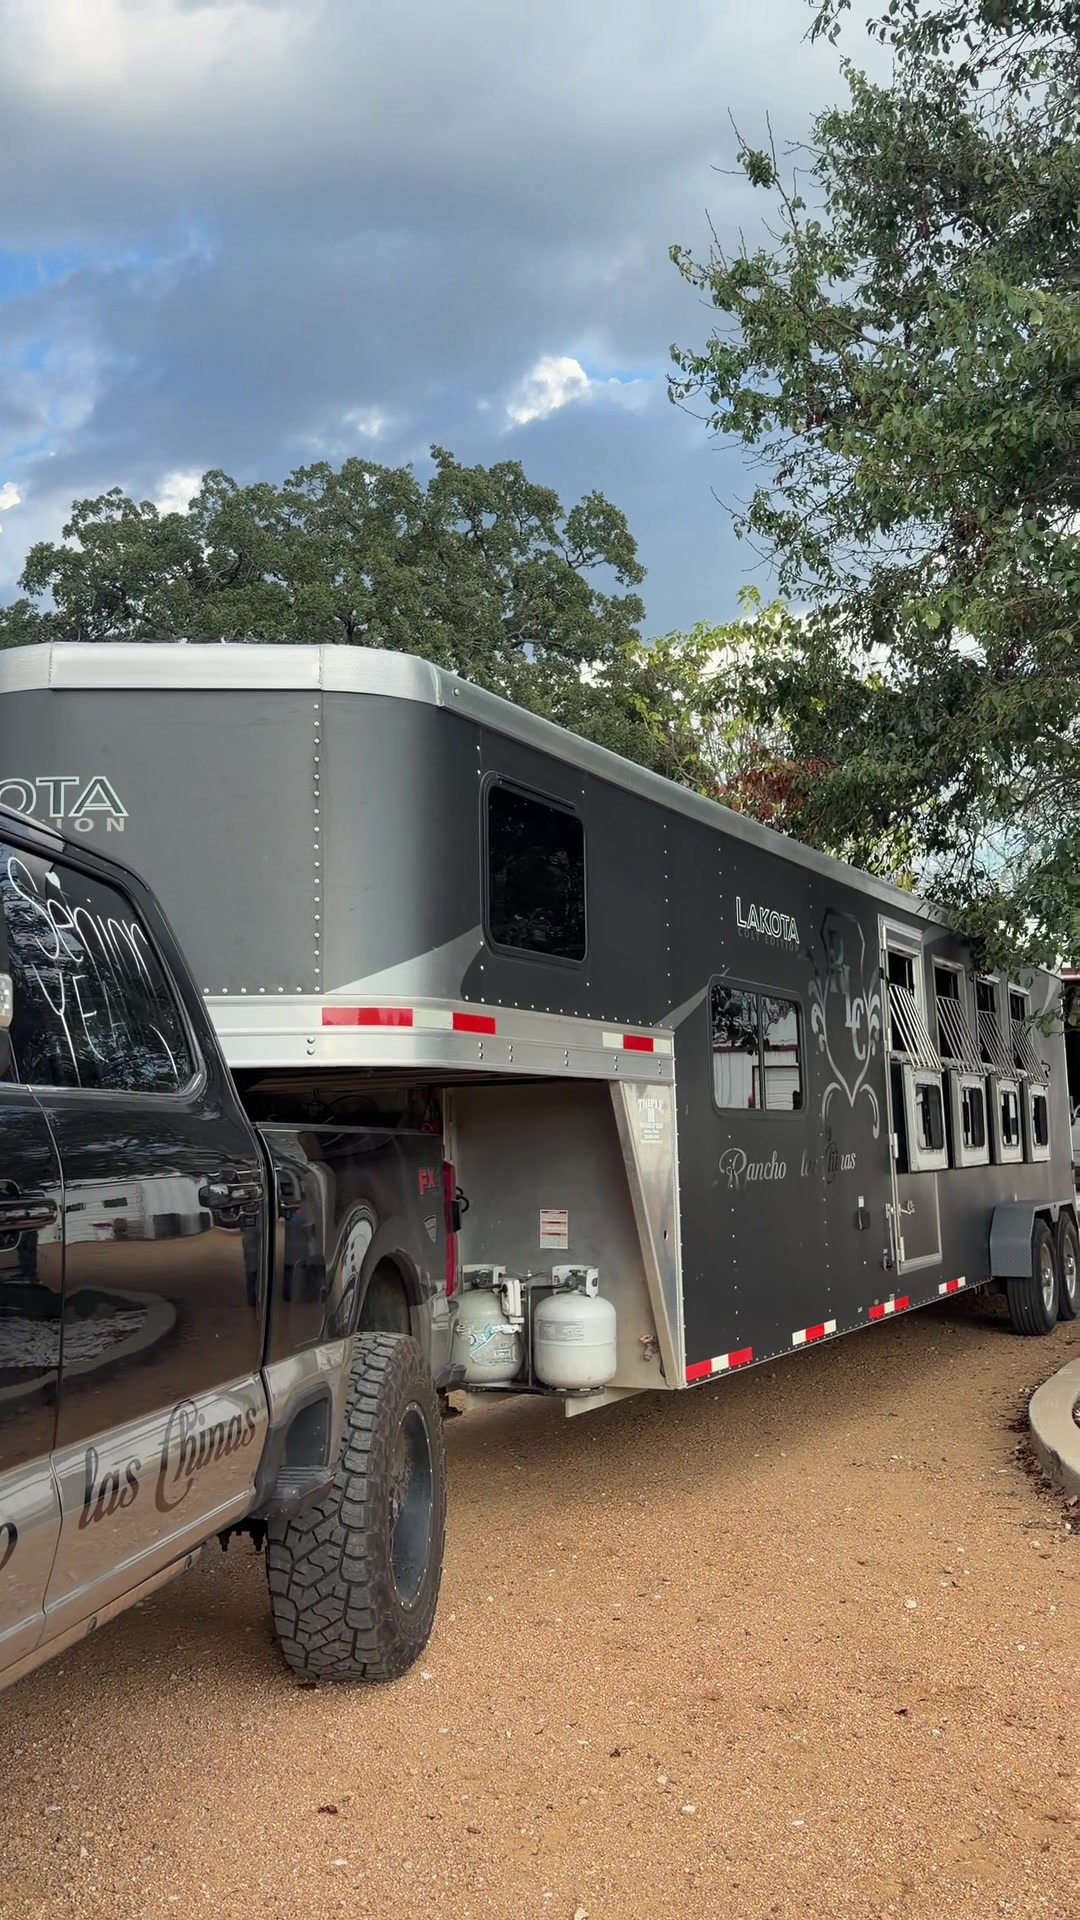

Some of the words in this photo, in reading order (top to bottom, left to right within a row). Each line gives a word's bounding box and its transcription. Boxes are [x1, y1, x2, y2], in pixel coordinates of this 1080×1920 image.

[736, 896, 800, 944] LAKOTA
[718, 1147, 787, 1190] Rancho
[78, 1447, 142, 1531] las
[155, 1398, 258, 1513] Chinas
